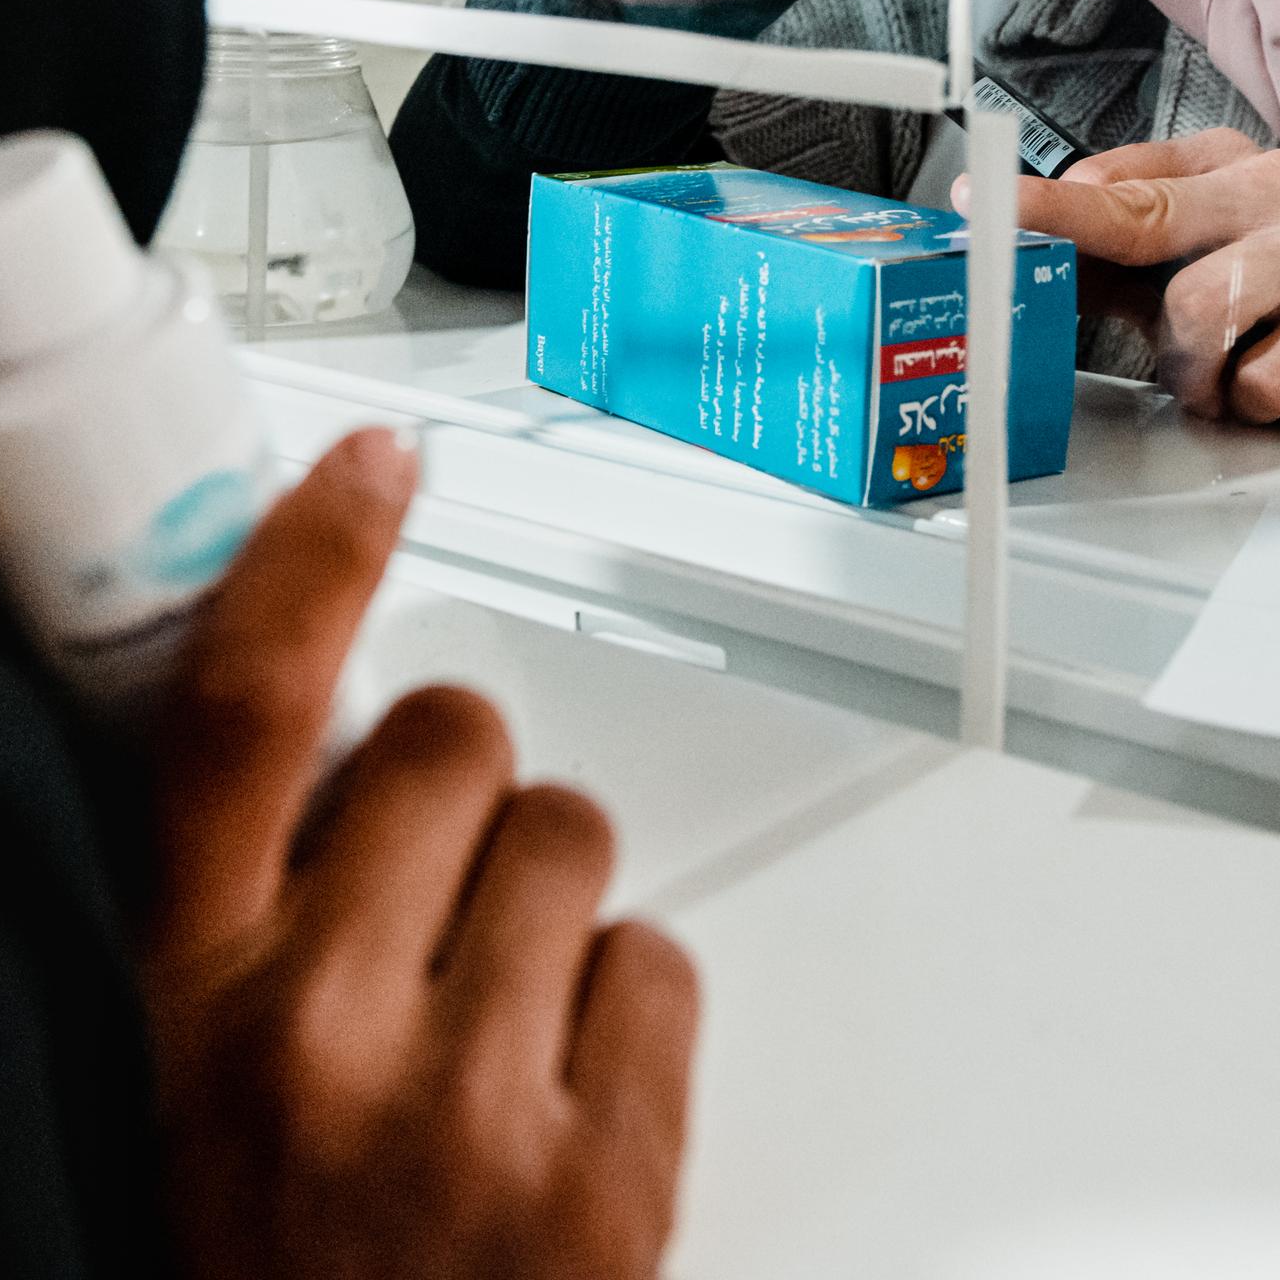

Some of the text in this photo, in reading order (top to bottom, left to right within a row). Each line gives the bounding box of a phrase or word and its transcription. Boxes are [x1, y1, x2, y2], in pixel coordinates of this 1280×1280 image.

[1034, 262, 1071, 284] 100 مل
[758, 287, 767, 304] عن
[933, 309, 966, 331] شراب
[717, 339, 724, 347] و
[737, 320, 747, 357] متناول
[758, 332, 766, 341] لا
[536, 334, 546, 376] Bayer
[893, 339, 968, 376] للحساسية
[735, 360, 743, 377] عن
[829, 359, 842, 384] على
[700, 364, 709, 402] النشرة
[753, 376, 765, 405] درجة
[829, 386, 841, 404] مل
[713, 397, 722, 436] لدواعي
[752, 405, 763, 421] في
[732, 410, 743, 442] يحفظ
[752, 421, 763, 449] يحفظ
[796, 420, 806, 440] من
[828, 417, 840, 437] كل
[797, 440, 808, 466] خال
[810, 429, 824, 461] ملجم
[825, 437, 839, 479] تحتوي
